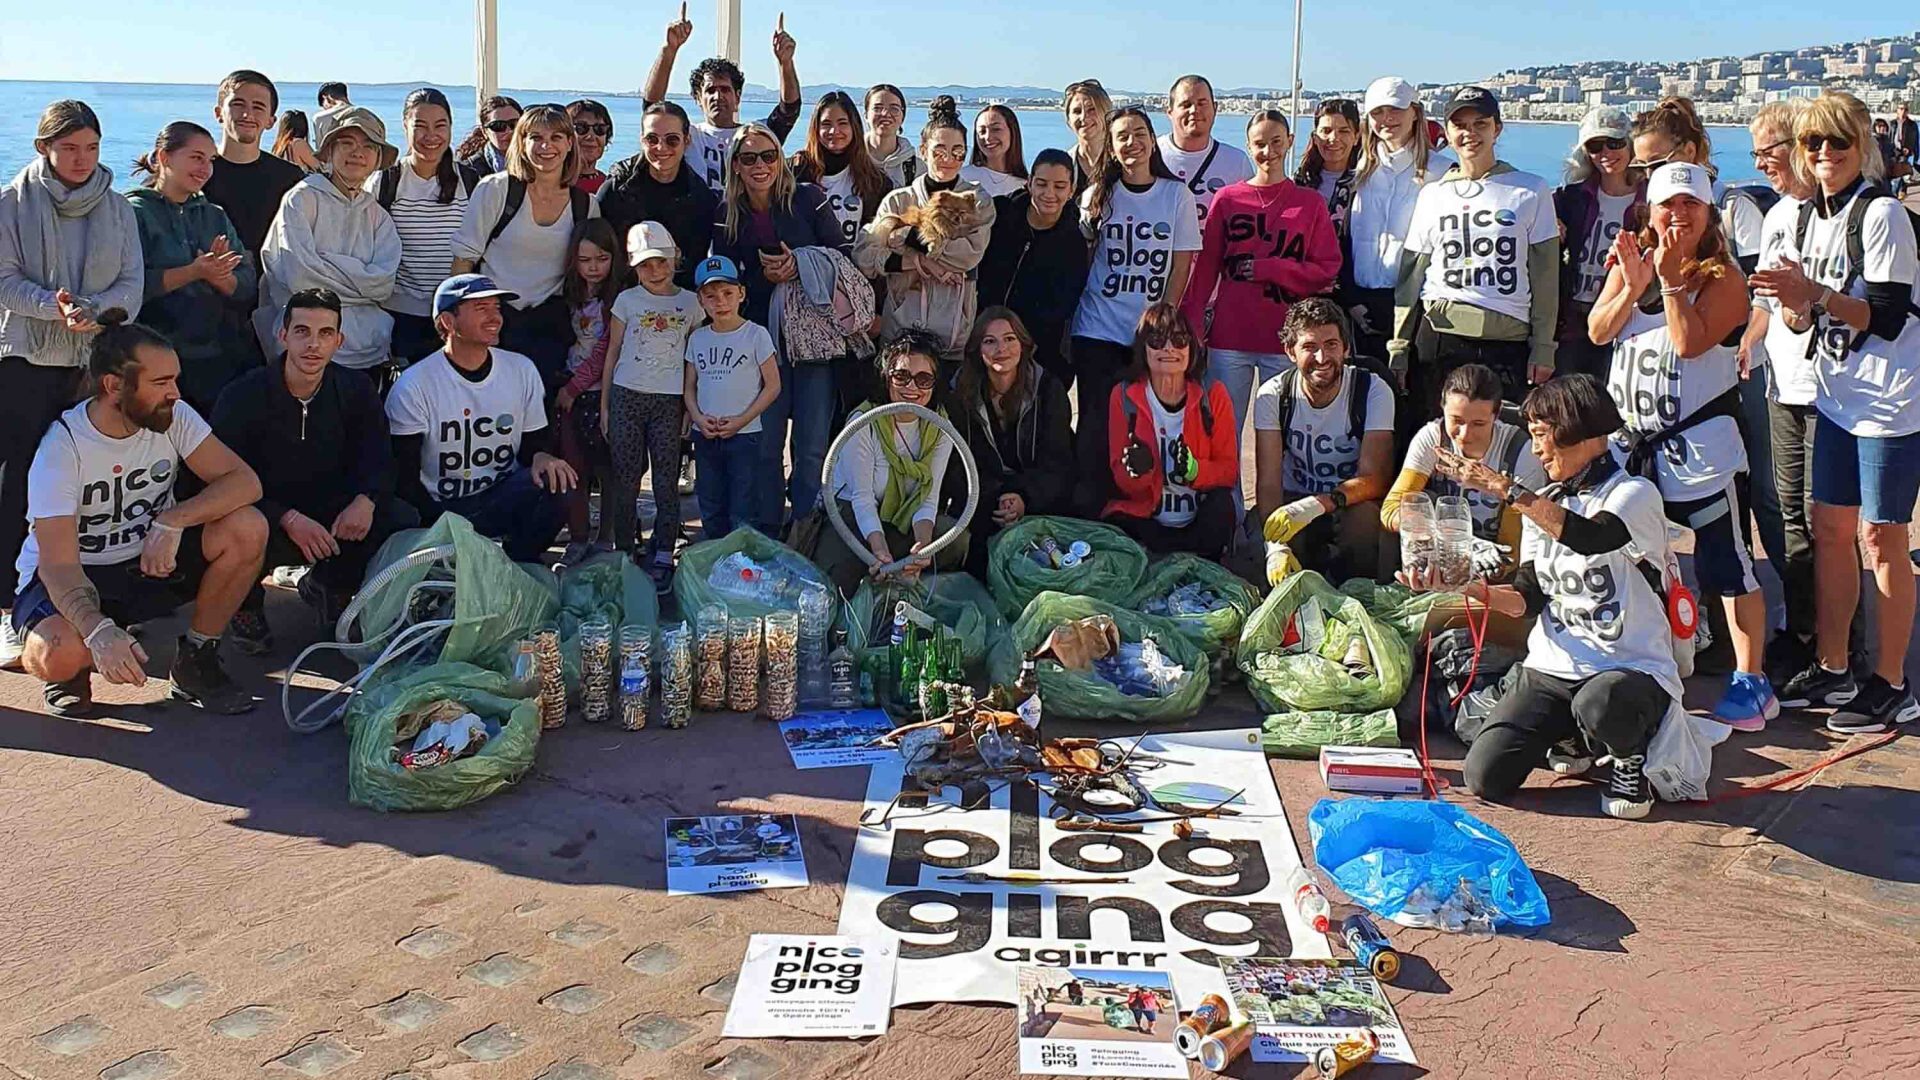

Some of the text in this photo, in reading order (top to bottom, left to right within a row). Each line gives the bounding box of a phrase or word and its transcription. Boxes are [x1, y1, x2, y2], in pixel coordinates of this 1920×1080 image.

[1107, 215, 1171, 240] nice
[1439, 205, 1517, 232] nice
[1107, 247, 1169, 276] plog
[1442, 236, 1517, 269] plog
[1101, 271, 1166, 302] ging
[1443, 266, 1517, 296] ging
[697, 346, 748, 370] SURF
[440, 408, 515, 443] nice
[439, 444, 515, 477] plog
[82, 458, 172, 507] nice
[885, 827, 1271, 897] plog
[708, 879, 769, 889] plogging
[717, 873, 758, 881] handi
[875, 888, 1295, 968] ging
[778, 941, 865, 958] nice
[993, 942, 1168, 968] agirrr
[773, 962, 863, 979] plog
[769, 978, 861, 995] ging
[1041, 1043, 1076, 1052] nice
[1041, 1052, 1077, 1061] plog
[1260, 1040, 1303, 1049] Chaque
[1041, 1059, 1078, 1068] ging
